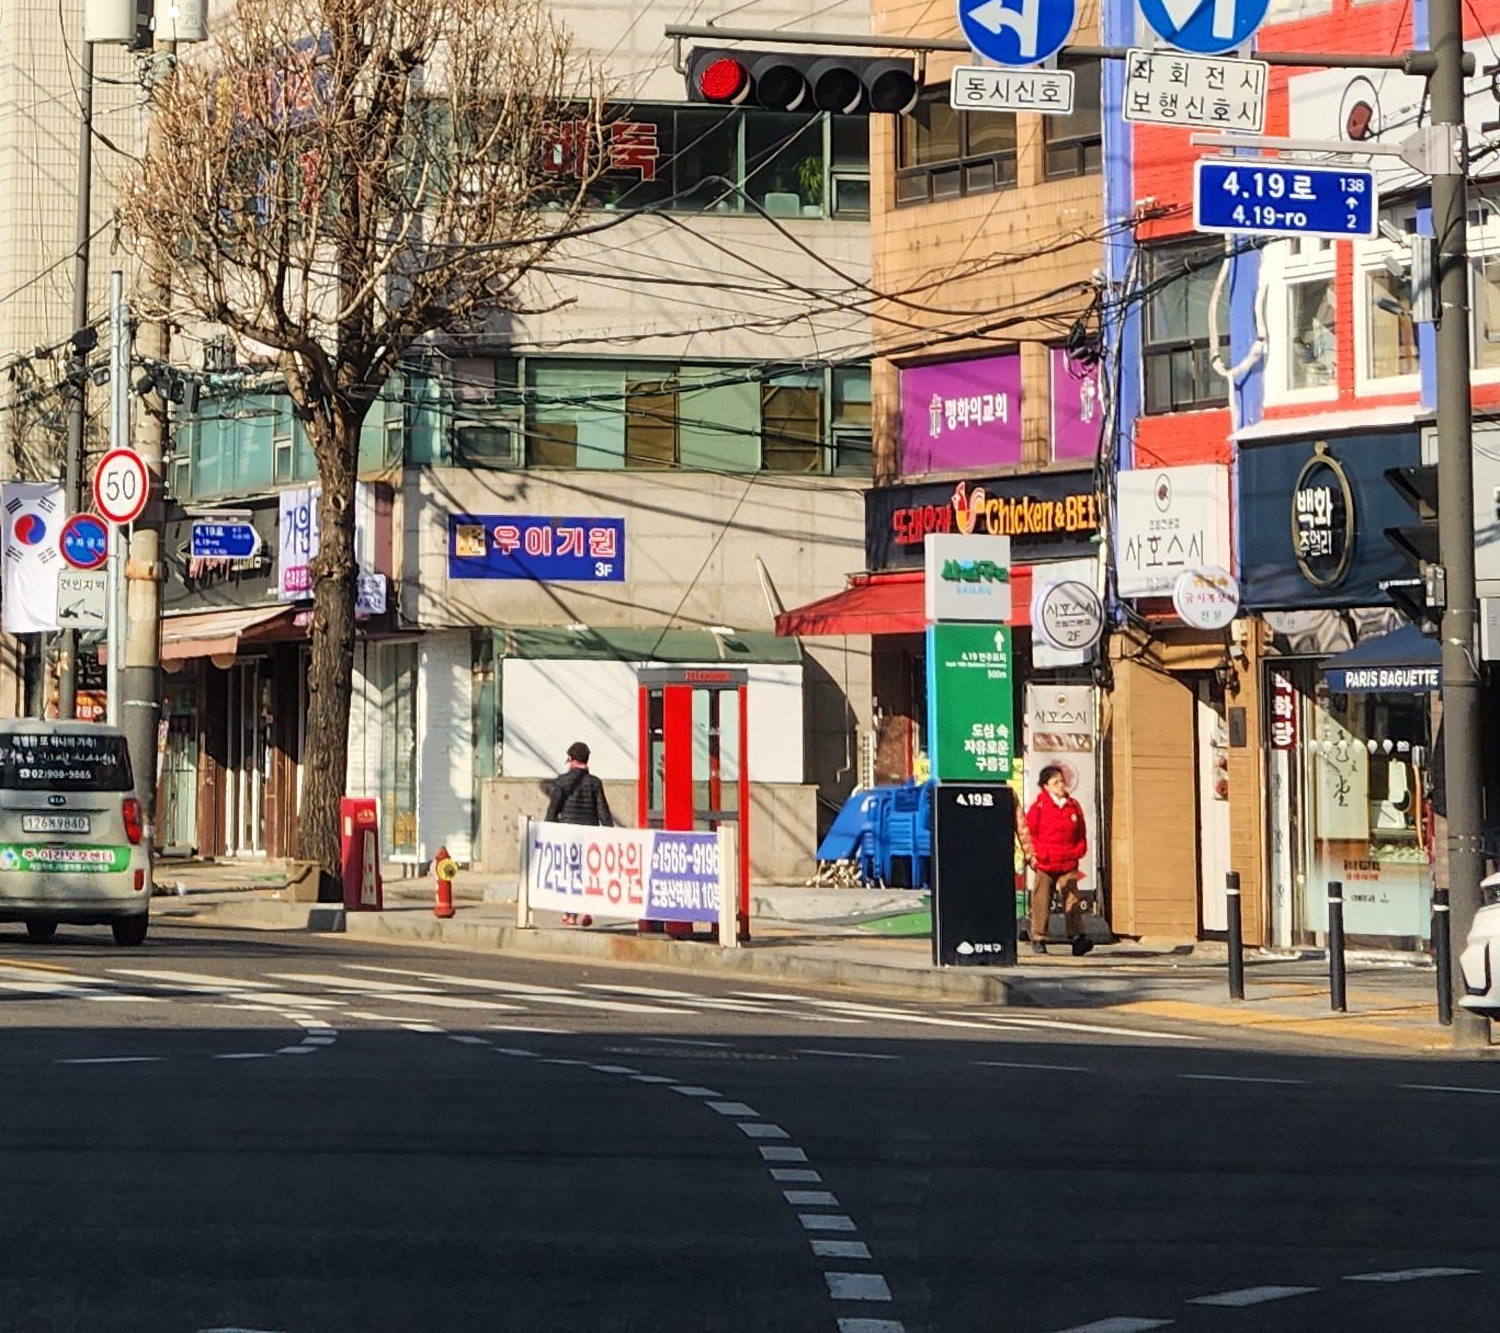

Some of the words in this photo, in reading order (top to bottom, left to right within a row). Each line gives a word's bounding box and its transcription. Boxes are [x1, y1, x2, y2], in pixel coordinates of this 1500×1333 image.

[964, 77, 1062, 105] 동시신호
[1129, 90, 1260, 127] 보행신호시
[1222, 171, 1317, 201] 4.19로
[1339, 178, 1365, 193] 138
[1231, 204, 1308, 228] 4.19-ro
[1345, 215, 1358, 229] 2
[944, 392, 1008, 430] 평화의교회
[106, 469, 136, 502] 50
[1297, 486, 1334, 528] 백화
[493, 525, 617, 558] 우이기원
[595, 561, 613, 577] 3F
[1066, 630, 1082, 643] 2F
[1345, 670, 1378, 689] PARIS
[1379, 669, 1439, 688] BAGUETTE
[971, 723, 995, 738] 도심
[995, 723, 1009, 738] 속
[964, 739, 1009, 755] 자유로운
[956, 792, 995, 807] 4.19로
[658, 841, 719, 875] 1566-9196
[534, 839, 583, 896] 72만원
[585, 841, 644, 905] 요양원
